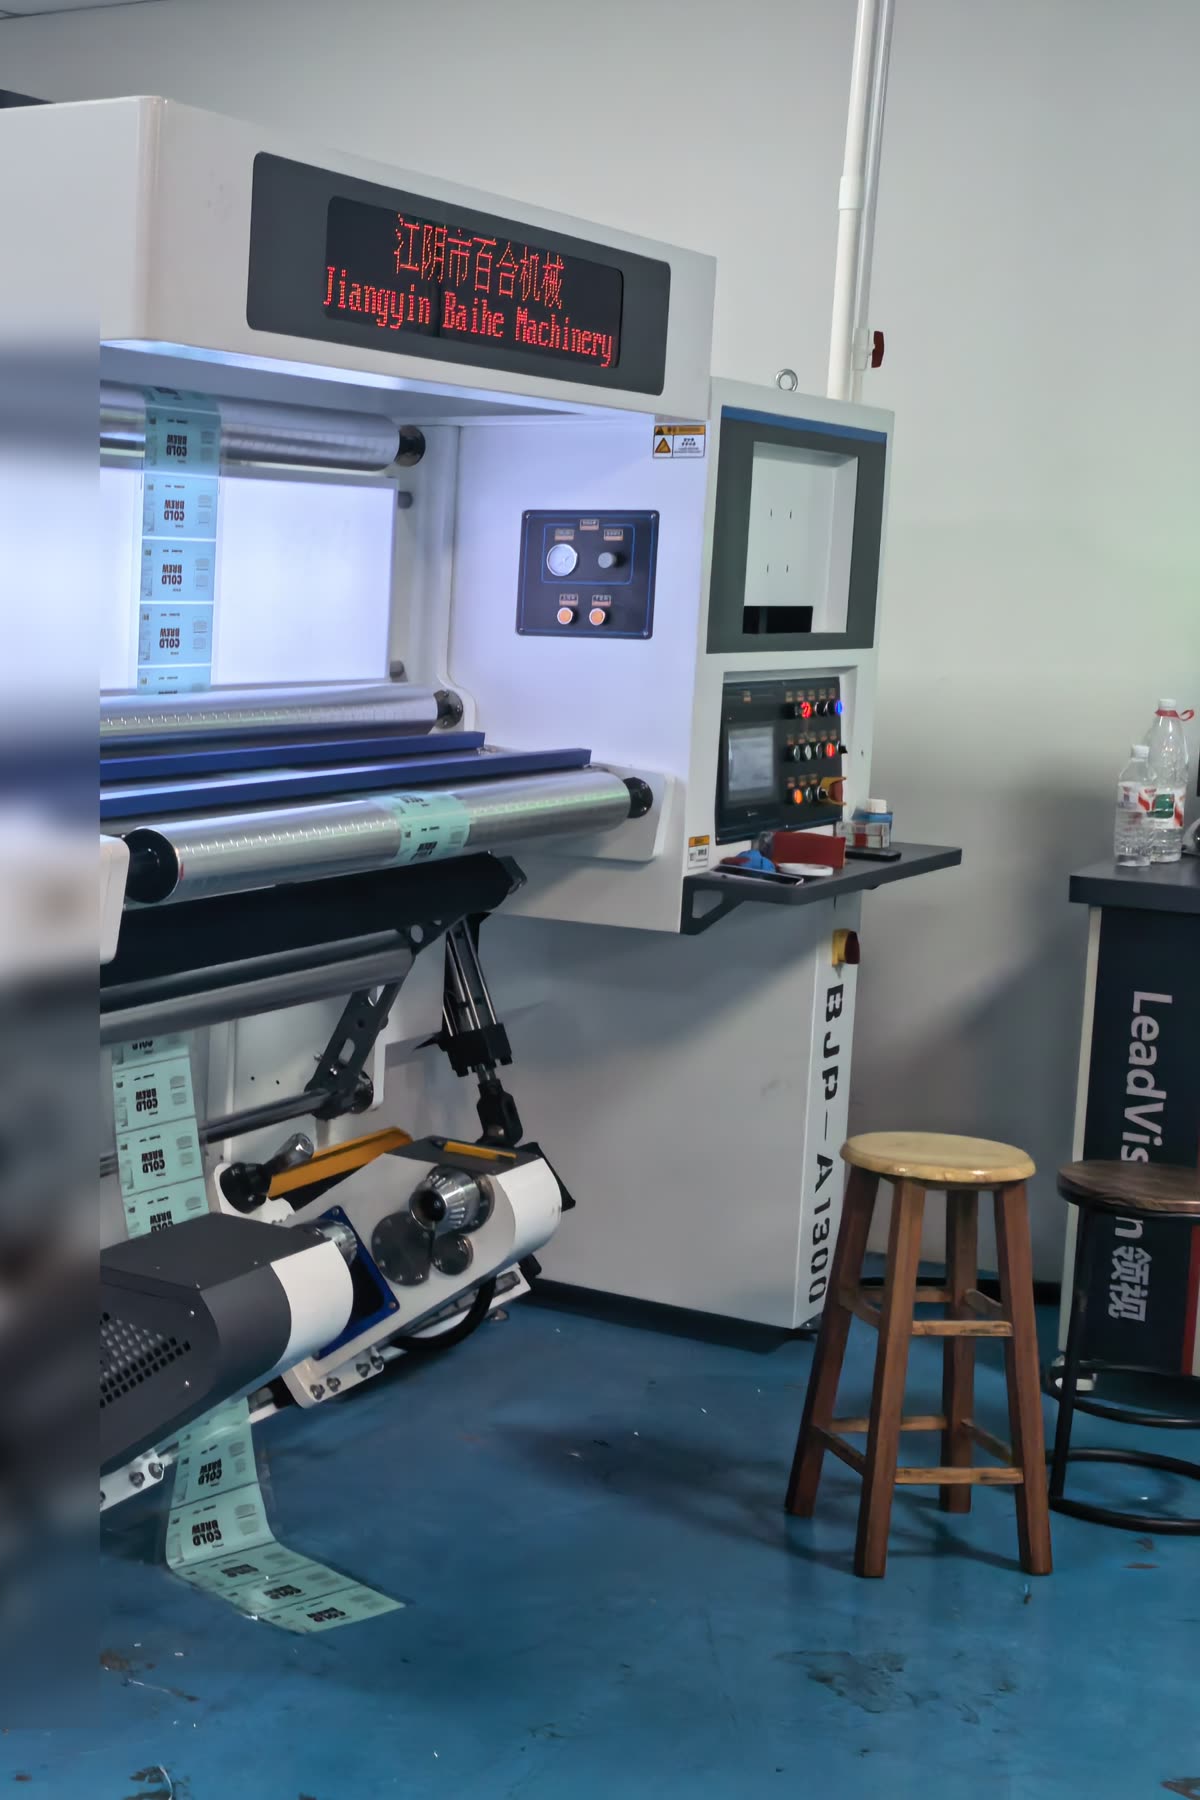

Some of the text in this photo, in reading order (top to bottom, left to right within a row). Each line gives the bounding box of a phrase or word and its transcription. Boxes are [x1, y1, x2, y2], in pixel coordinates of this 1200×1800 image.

[394, 212, 565, 310] 江阴市百合机械
[323, 265, 613, 368] Jiangyin Baihe Machinery
[166, 445, 187, 457] COLD
[164, 510, 185, 521] COLD
[162, 564, 182, 574] BREW
[161, 575, 182, 585] COLD
[159, 638, 180, 649] COLD
[135, 1088, 157, 1101] BREW
[136, 1098, 158, 1112] COLD
[1114, 990, 1173, 1240] LeadVisn
[141, 1149, 164, 1163] BREW
[142, 1160, 165, 1174] COLD
[150, 1210, 173, 1225] BREW
[1108, 1245, 1152, 1322] 领视
[198, 1469, 222, 1486] COLD
[192, 1530, 222, 1547] COLD
